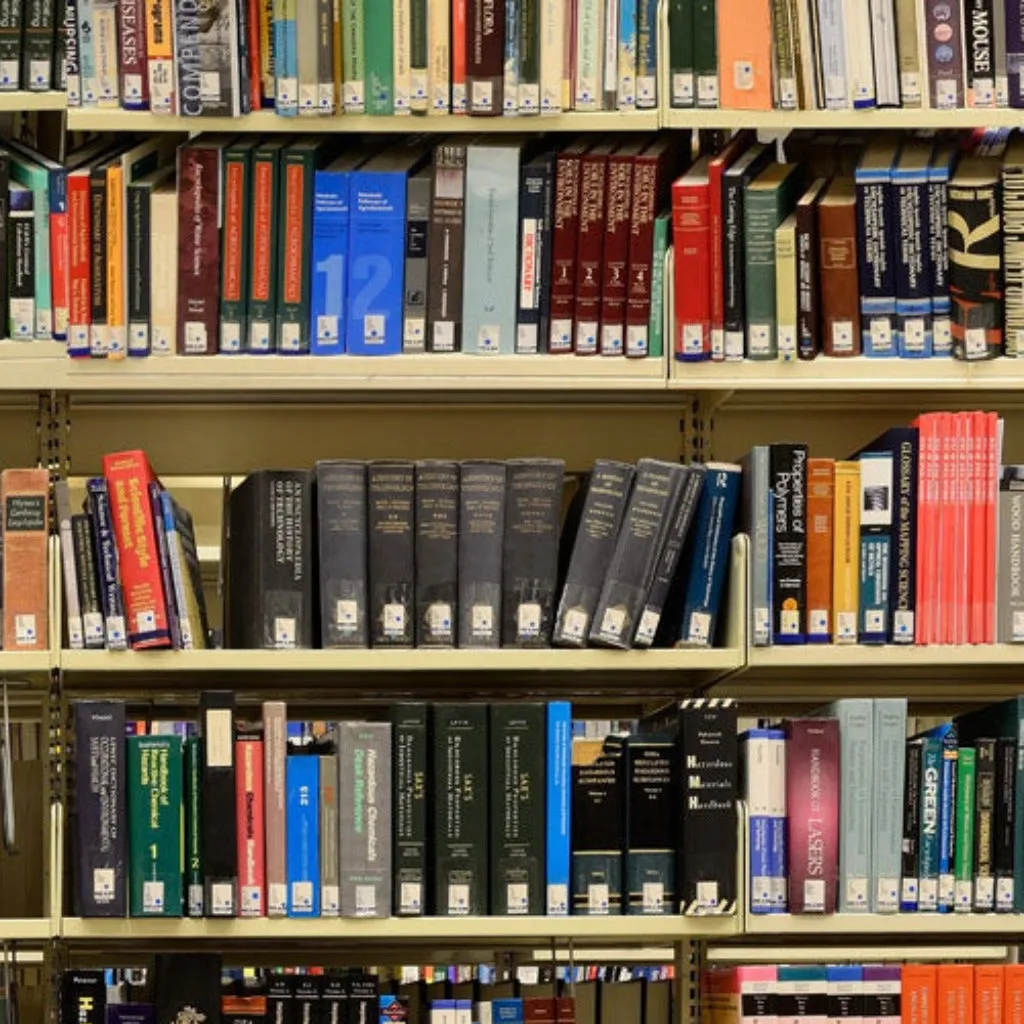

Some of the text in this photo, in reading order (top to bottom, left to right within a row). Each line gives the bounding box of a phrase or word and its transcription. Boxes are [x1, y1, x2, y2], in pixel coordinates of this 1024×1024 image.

[122, 0, 136, 64] ISEASES
[971, 10, 989, 72] MOUSE
[773, 472, 790, 533] Polymers
[791, 450, 805, 533] Properties of
[924, 767, 937, 833] GREEN
